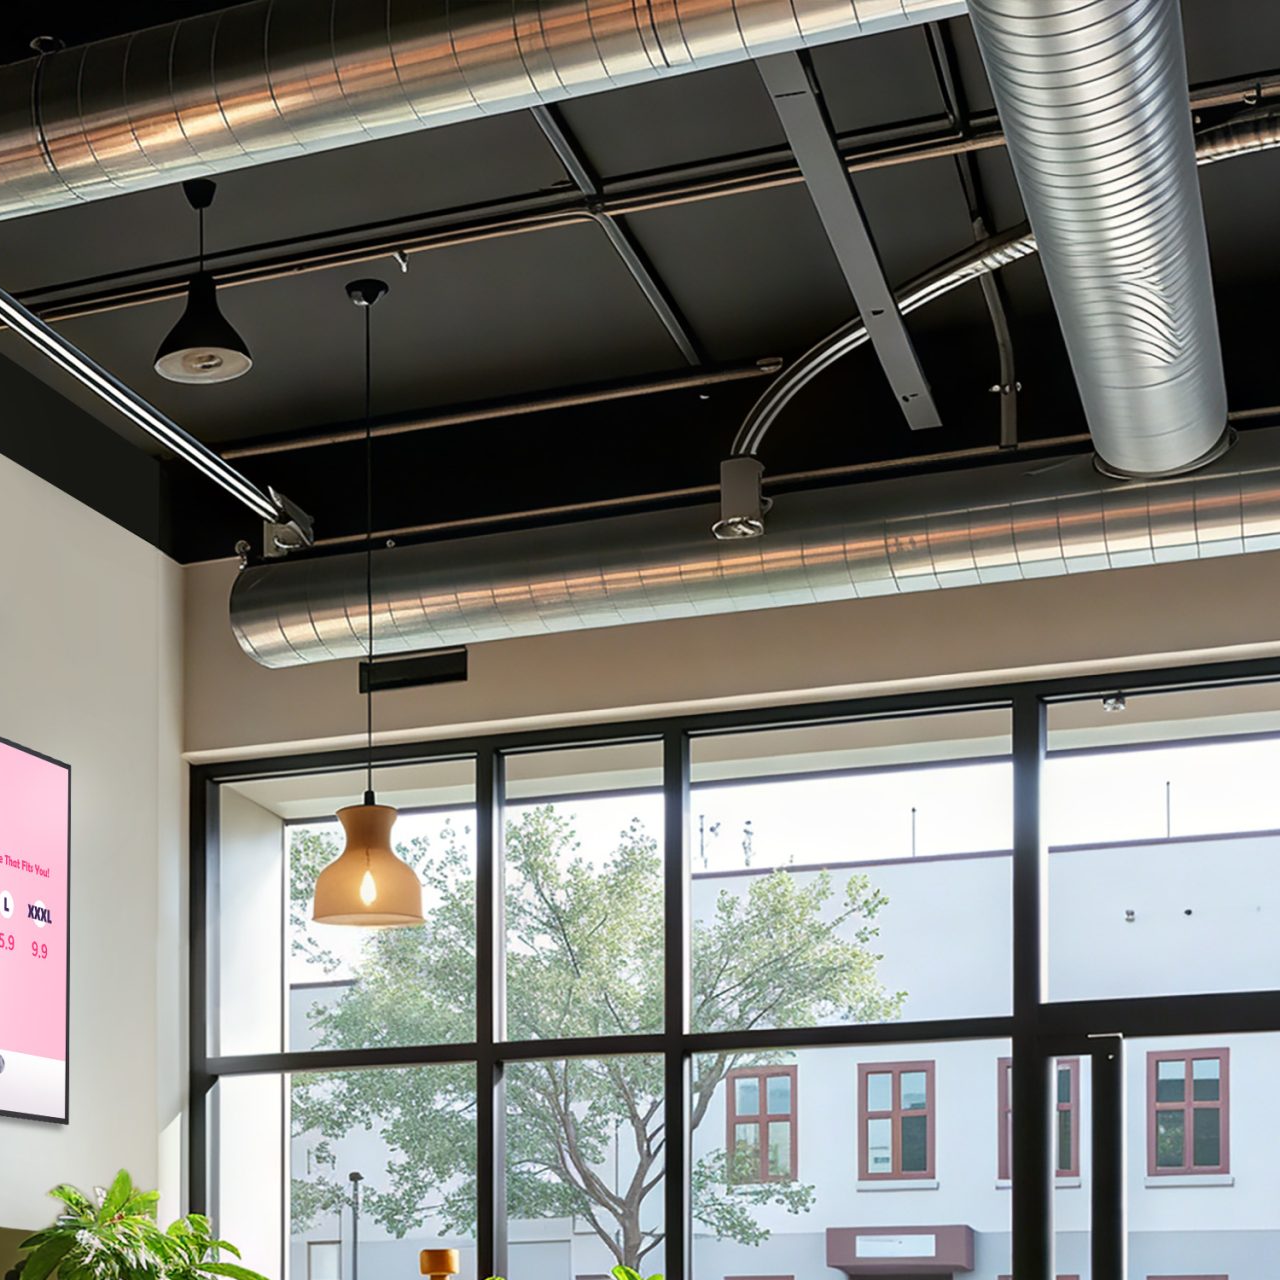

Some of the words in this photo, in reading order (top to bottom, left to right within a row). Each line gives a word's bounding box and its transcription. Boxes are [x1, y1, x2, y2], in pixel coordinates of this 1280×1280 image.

[5, 855, 21, 869] That
[21, 860, 33, 873] Fits
[35, 864, 50, 878] You!
[4, 897, 10, 912] L
[28, 904, 53, 924] XXXL
[31, 941, 48, 959] 9.9
